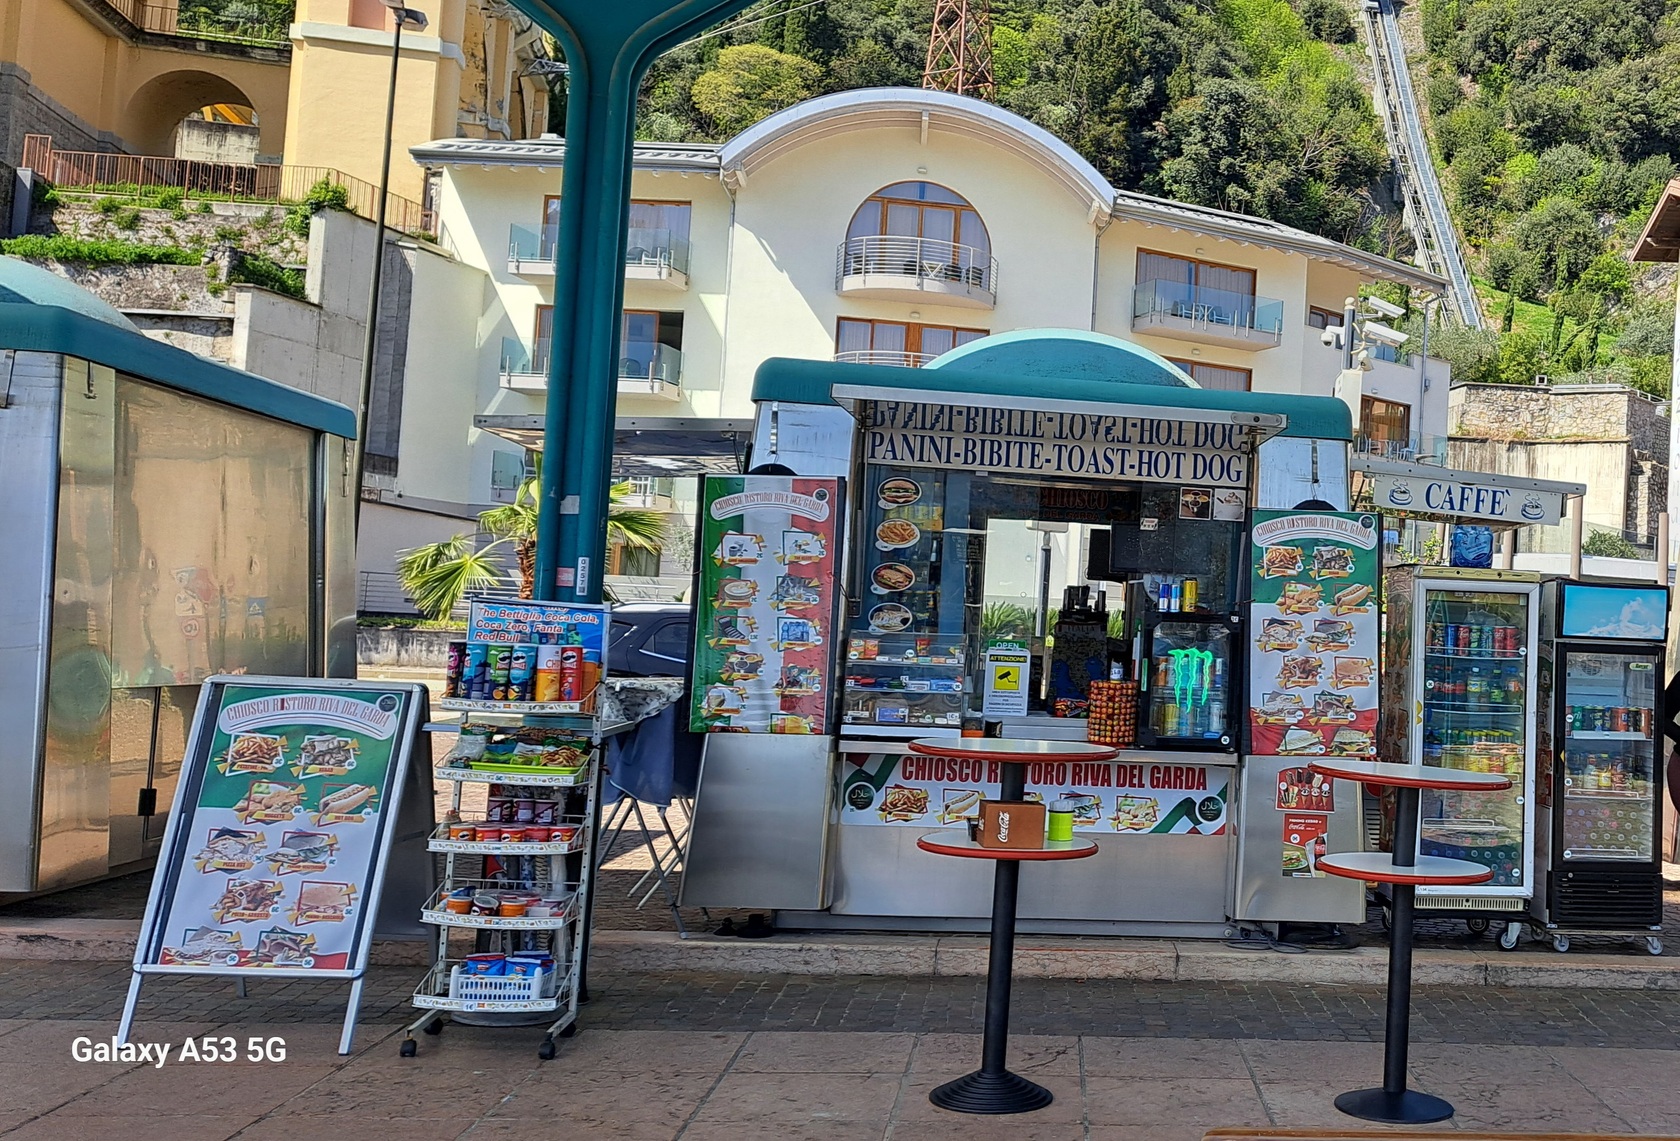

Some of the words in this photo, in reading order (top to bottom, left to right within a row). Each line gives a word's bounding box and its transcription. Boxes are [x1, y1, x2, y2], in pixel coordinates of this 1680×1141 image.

[1191, 453, 1243, 482] DOG
[714, 498, 742, 511] CHIOSCO
[743, 492, 773, 504] RISTORO
[774, 492, 789, 503] RIVA
[790, 495, 802, 506] DEL
[803, 498, 825, 513] GARDA
[1256, 520, 1286, 537] CHIOSCO
[1286, 516, 1318, 528] RISTORO
[1319, 517, 1335, 528] RIVA
[1336, 520, 1349, 531] DEL
[1349, 524, 1372, 541] GARDA
[476, 619, 502, 629] Coca
[505, 621, 531, 632] Zero,
[533, 623, 564, 633] Fanta
[478, 607, 496, 618] The
[545, 612, 570, 622] Coca
[573, 613, 599, 624] Cola,
[474, 631, 497, 641] Red
[498, 633, 520, 642] Bull
[226, 698, 270, 722] CHIOSCO
[272, 696, 317, 712] RISTORO
[318, 697, 339, 713] RIVA
[342, 702, 358, 718] DEL
[359, 706, 391, 729] GARDA
[902, 756, 982, 783] CHIOSCO
[1071, 763, 1113, 788] RIVA
[1116, 765, 1146, 789] DEL
[1149, 766, 1207, 791] GARDA
